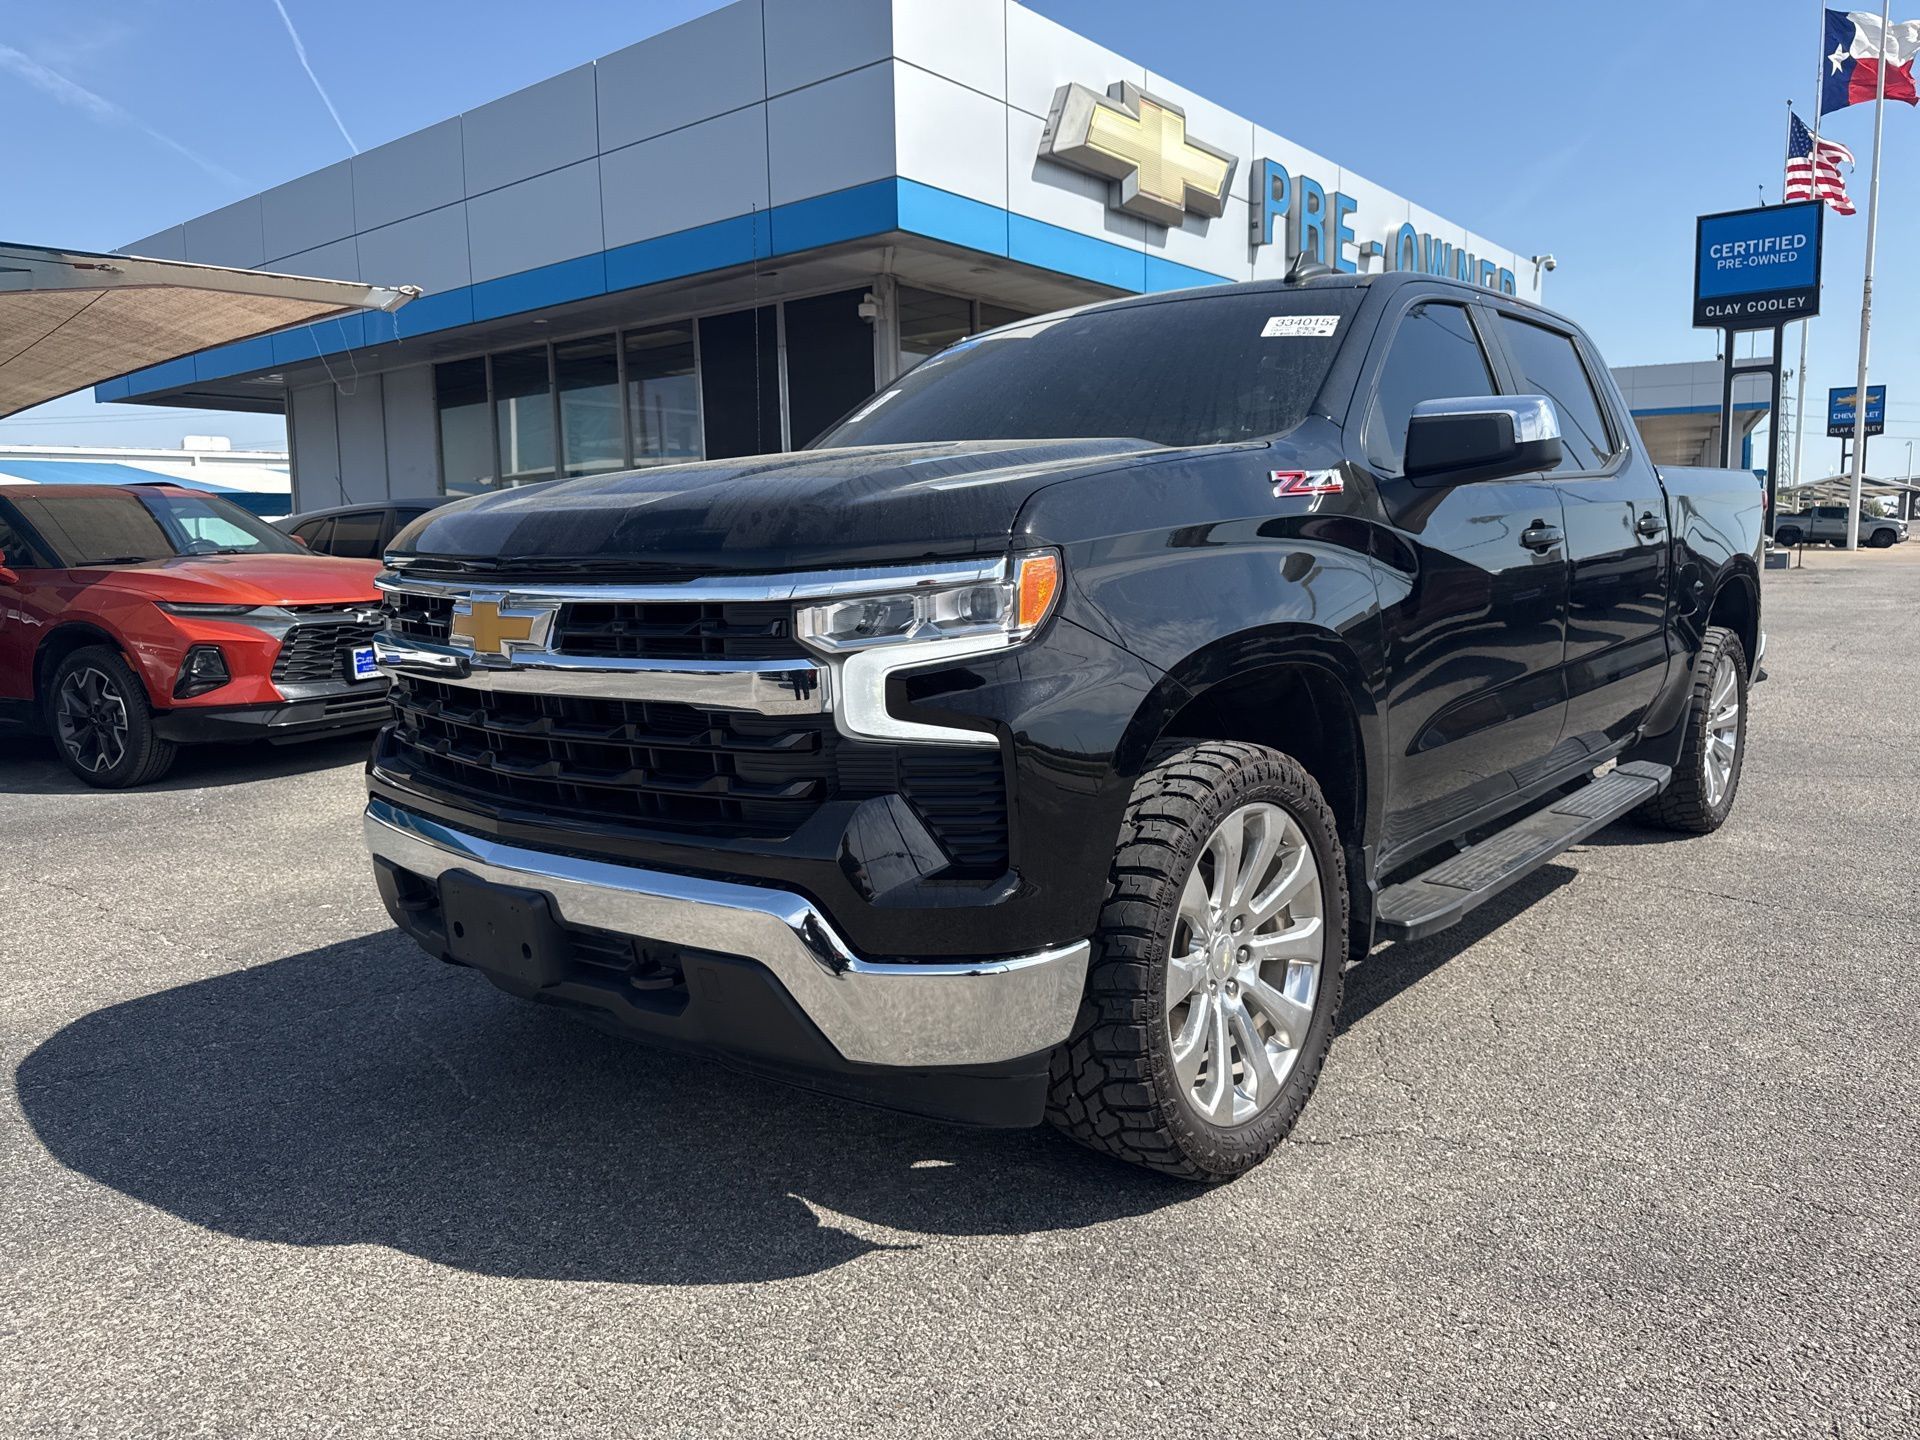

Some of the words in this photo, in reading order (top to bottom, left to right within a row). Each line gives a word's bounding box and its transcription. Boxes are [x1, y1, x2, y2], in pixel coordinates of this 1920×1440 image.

[1710, 234, 1807, 259] CERTIFIED
[1717, 251, 1798, 270] PRE-OWNED
[1706, 303, 1741, 317] CLAY
[1747, 296, 1806, 313] COOLEY
[1833, 411, 1880, 420] CHEVLET
[1851, 425, 1882, 433] COLEY
[1268, 469, 1345, 498] Z71
